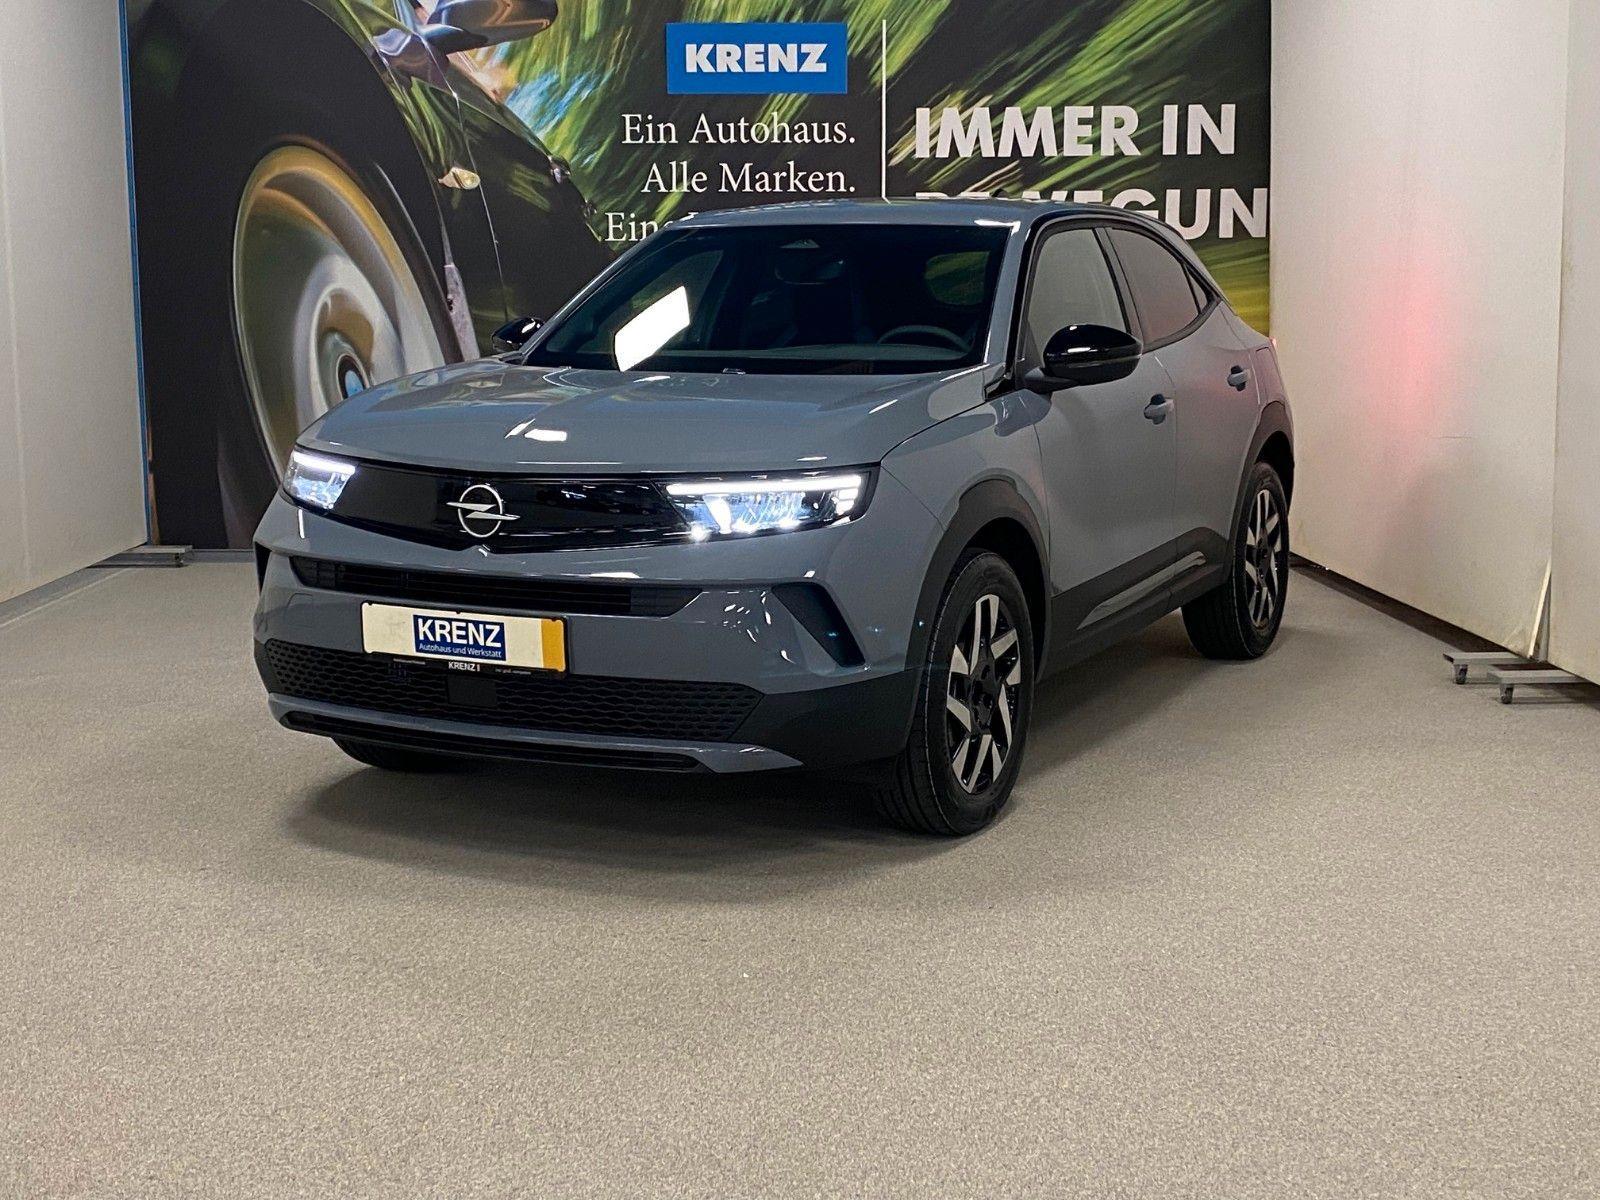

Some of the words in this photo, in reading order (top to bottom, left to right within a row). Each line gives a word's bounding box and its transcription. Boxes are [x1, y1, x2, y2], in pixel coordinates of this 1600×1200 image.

[685, 43, 827, 73] KRENZ
[621, 113, 678, 144] Ein
[688, 111, 856, 144] Autohaus.
[914, 105, 1141, 158] IMMER
[1162, 103, 1236, 156] IN
[640, 160, 708, 193] Alle
[718, 160, 856, 193] Marken.
[604, 212, 674, 242] Ein
[417, 617, 502, 648] KRENZ
[418, 643, 452, 654] Autohaus
[452, 646, 467, 655] und
[467, 647, 502, 659] Werkstatt
[448, 661, 476, 672] KRENZ
